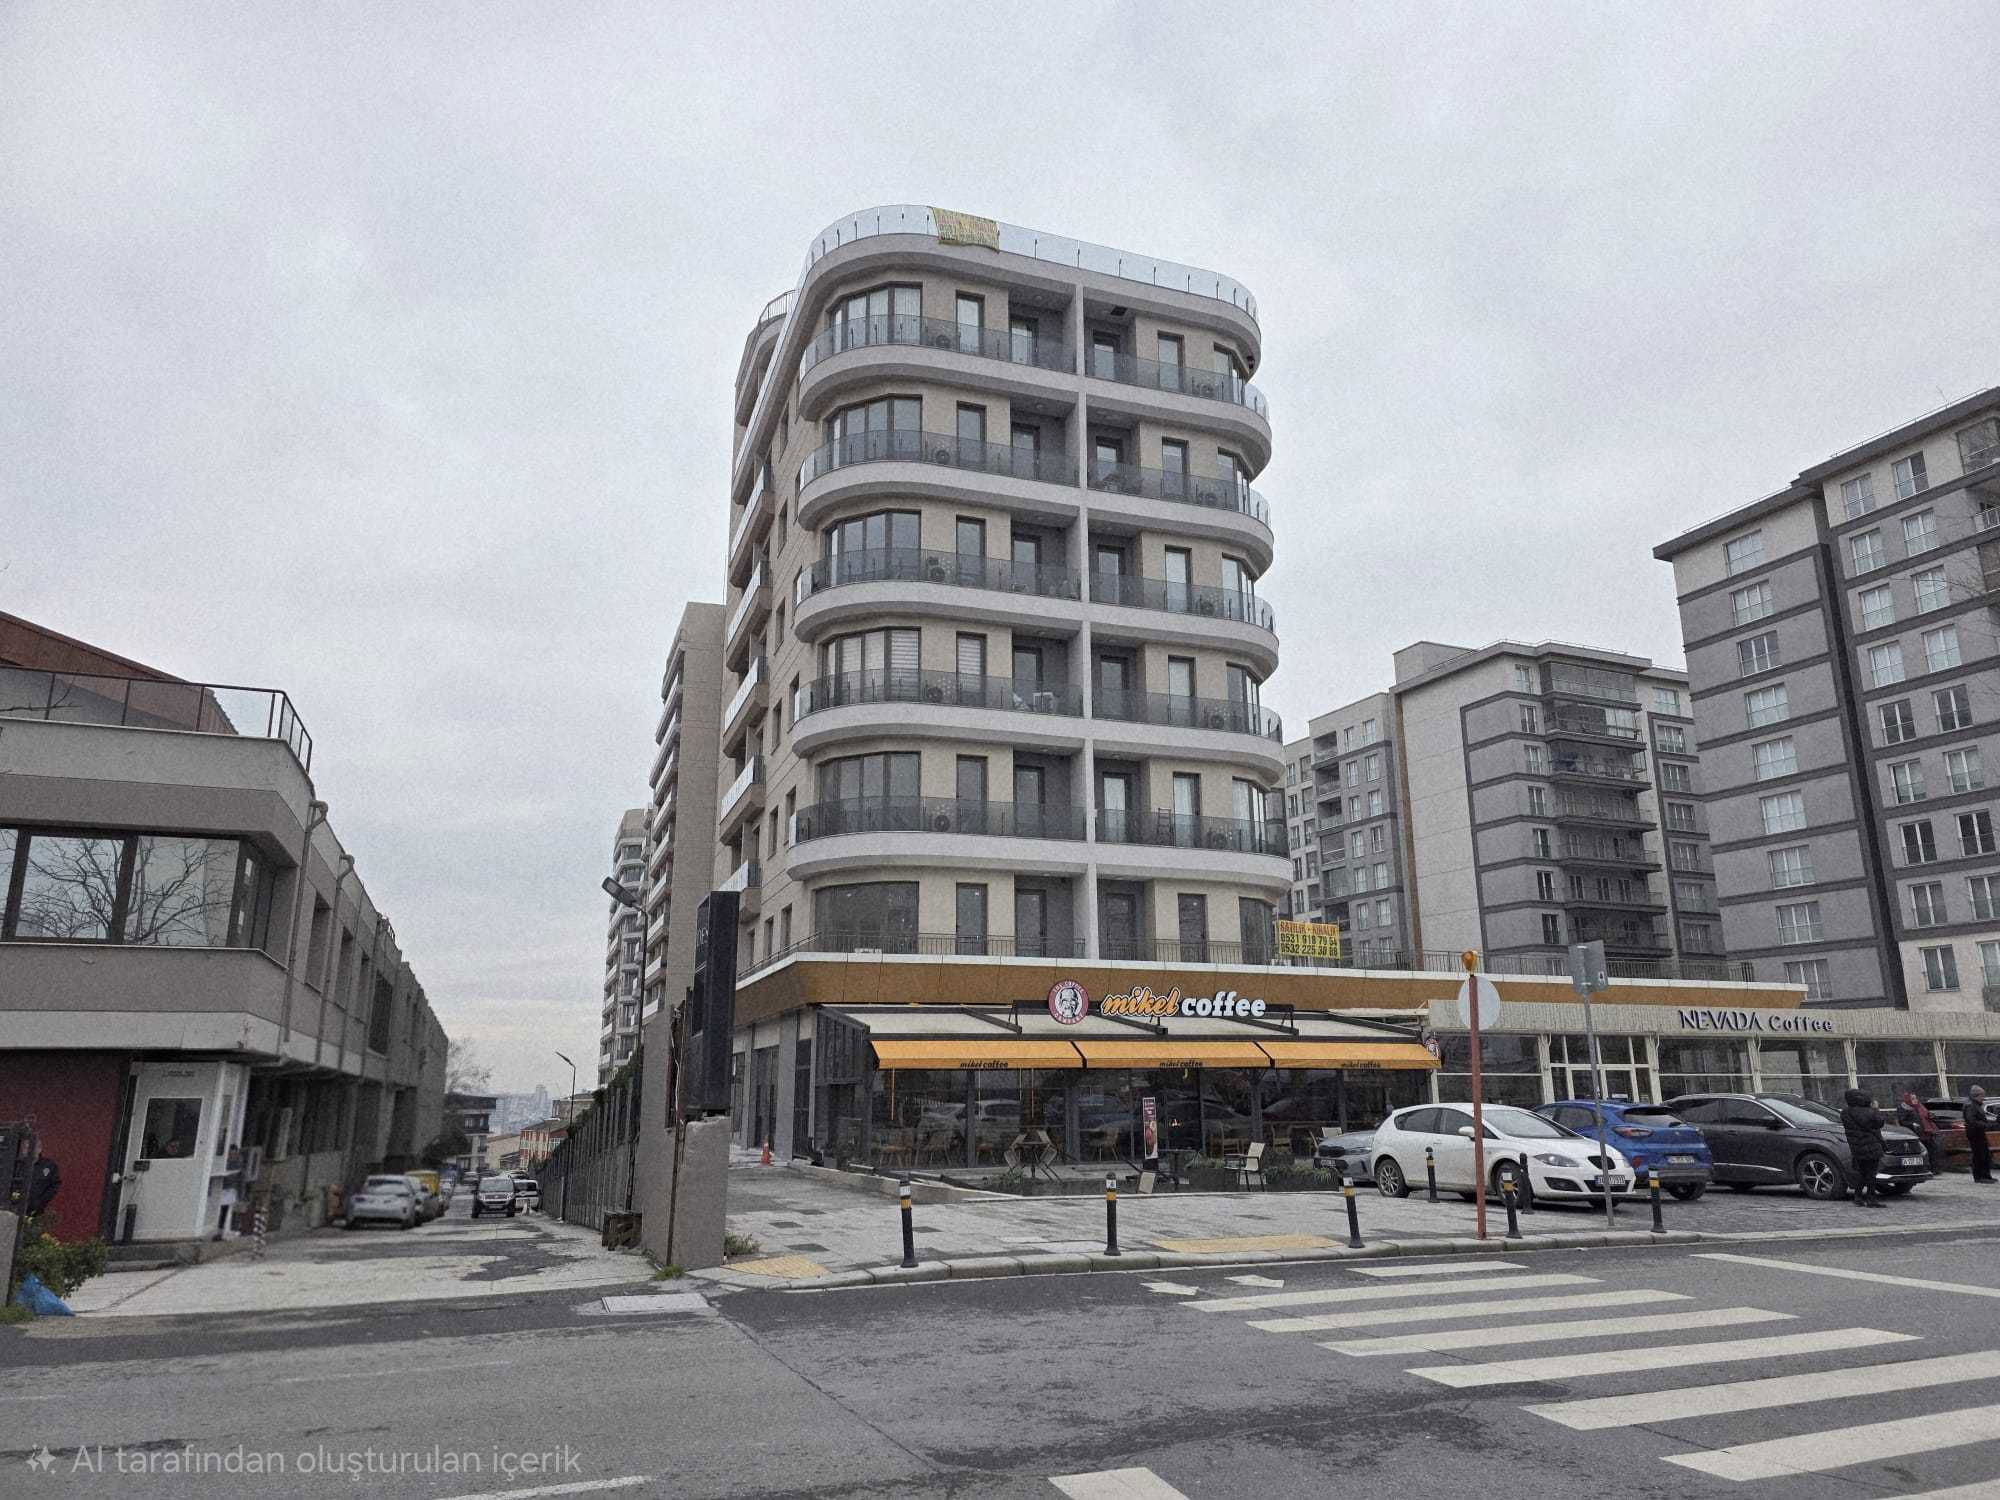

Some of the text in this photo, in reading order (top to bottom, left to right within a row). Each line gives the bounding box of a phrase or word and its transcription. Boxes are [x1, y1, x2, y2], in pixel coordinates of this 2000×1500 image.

[1101, 986, 1266, 1017] mikel coffee
[1678, 1009, 1832, 1032] NEVADA Coffee
